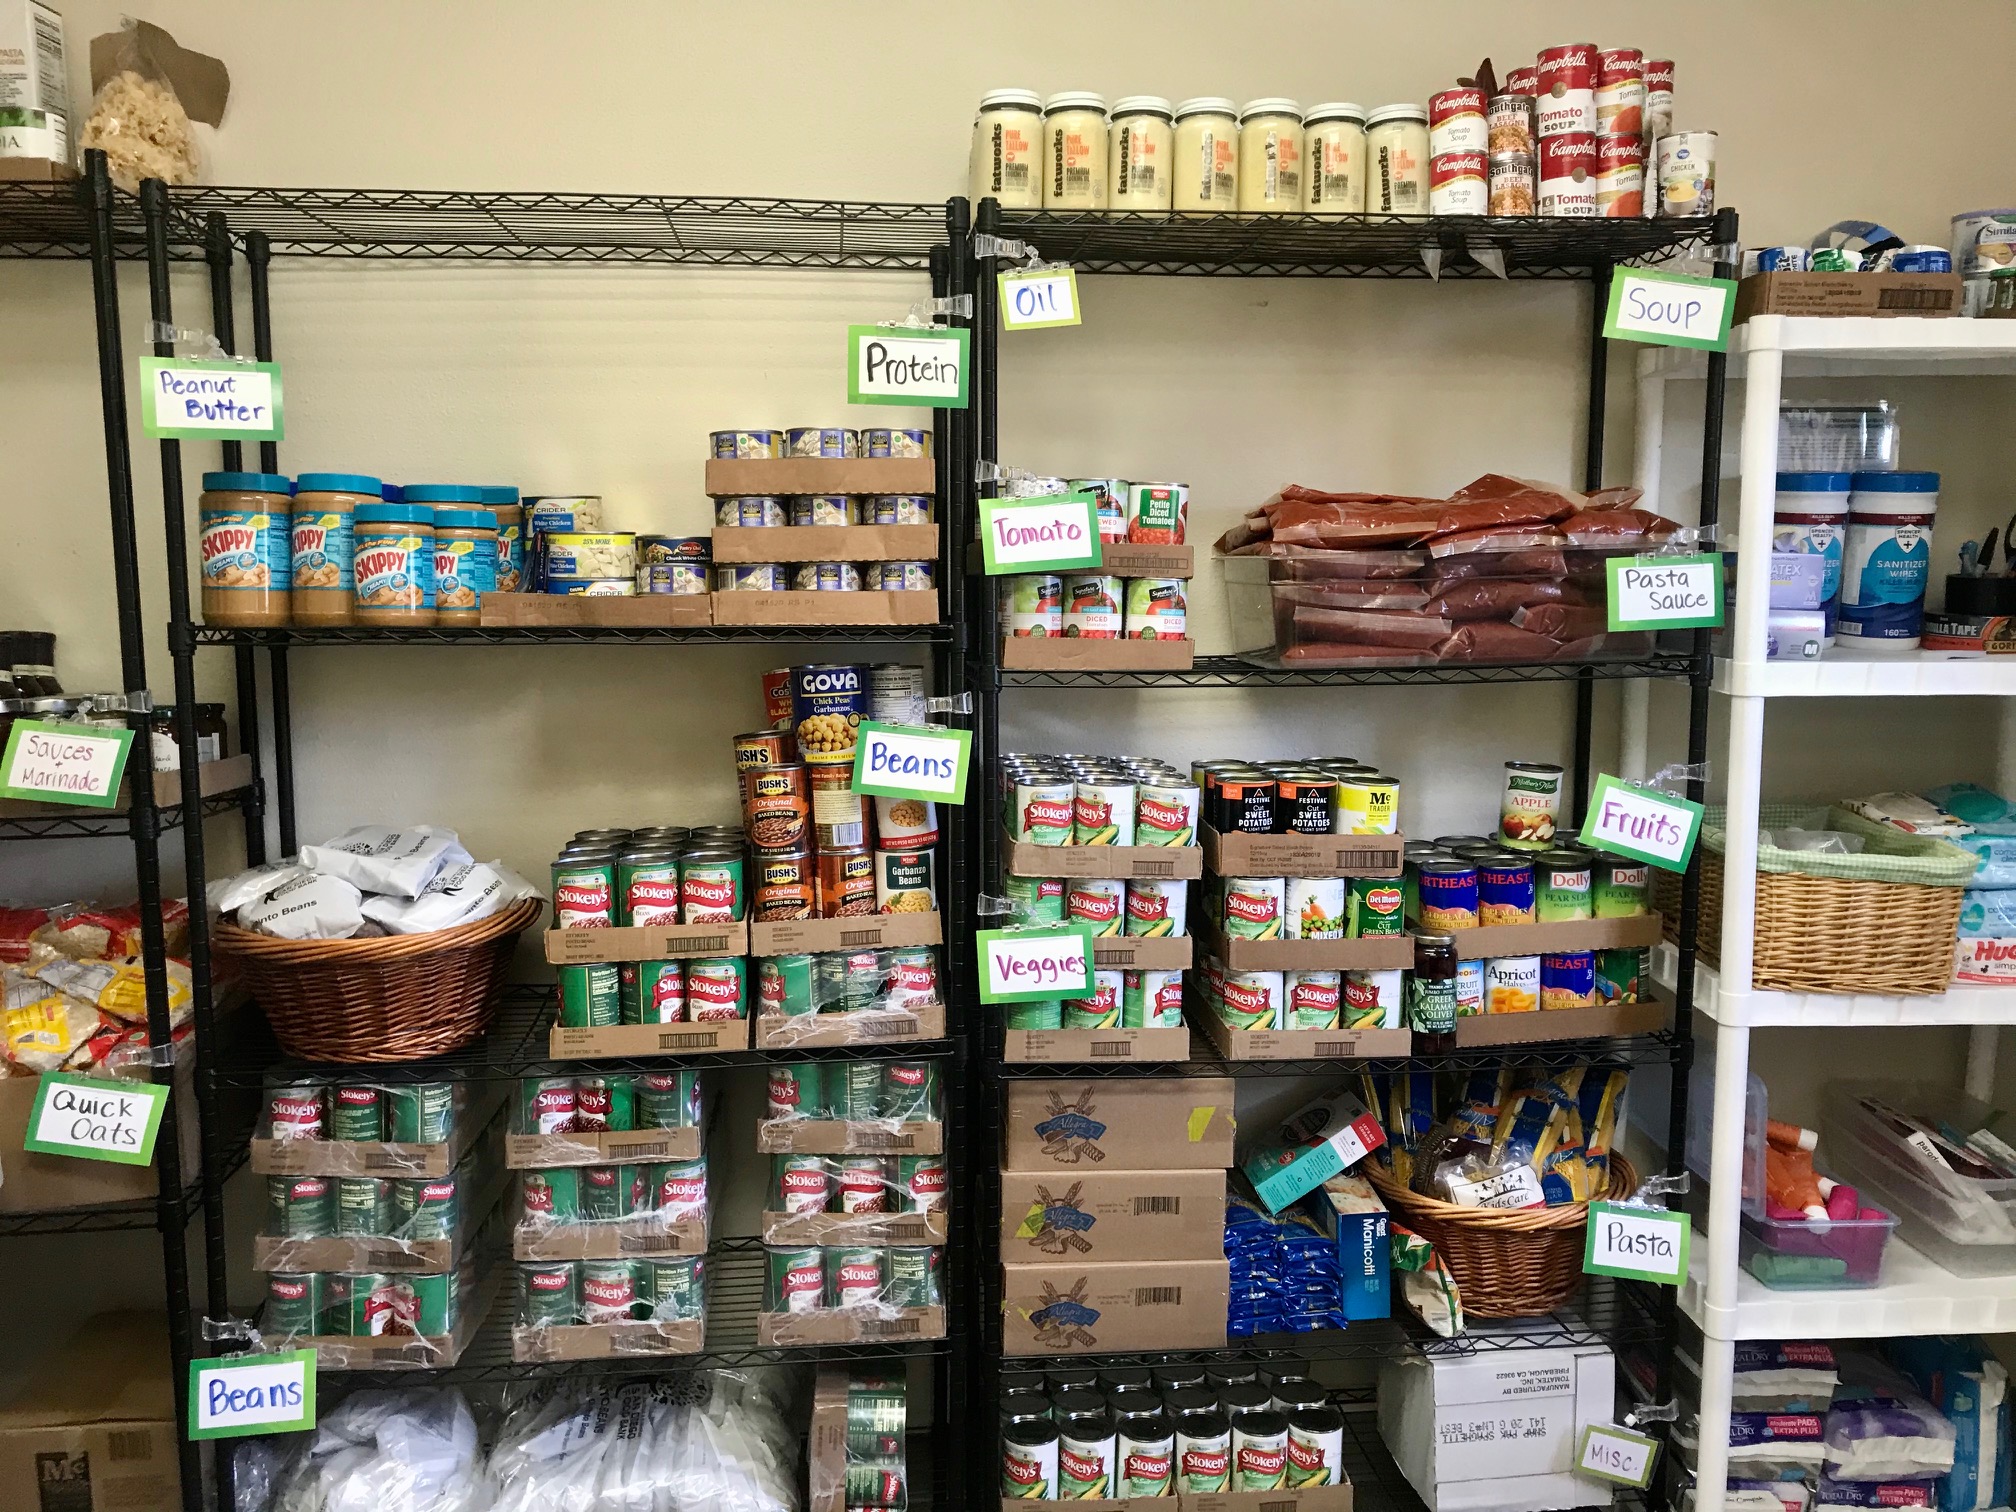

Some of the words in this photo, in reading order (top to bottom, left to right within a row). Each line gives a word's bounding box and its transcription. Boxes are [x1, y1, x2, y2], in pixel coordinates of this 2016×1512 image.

[1435, 93, 1481, 112] Campbell's
[1540, 107, 1583, 123] Tomato
[1447, 127, 1471, 136] Tomato
[1544, 121, 1576, 132] SOUP
[1005, 130, 1021, 140] PURE
[1066, 134, 1082, 145] PURE
[1450, 134, 1468, 142] Soup
[991, 122, 1002, 192] fatworks
[1053, 129, 1063, 198] fatworks
[1118, 126, 1130, 195] fatworks
[1311, 137, 1322, 204] fatworks
[1436, 157, 1482, 173] Campbell's
[1379, 145, 1392, 212] fatworks
[1563, 206, 1593, 215] SOUP
[1985, 223, 2016, 237] Simila
[1015, 284, 1058, 316] Oil
[866, 341, 958, 385] Protein
[160, 370, 237, 395] Peanut
[184, 398, 267, 422] Butter
[1149, 499, 1171, 509] Petite
[1149, 508, 1170, 517] Diced
[1141, 516, 1176, 526] Tomatoes
[993, 516, 1082, 548] Tomato
[201, 528, 254, 561] SKIPPY
[355, 551, 405, 584] SKIPPY
[1770, 564, 1802, 576] ATEX
[1876, 560, 1927, 568] SANITIZER
[1625, 568, 1690, 590] Pasta
[1889, 570, 1918, 578] WIPES
[1883, 628, 1900, 637] 160
[1951, 622, 1979, 636] TAPE
[802, 672, 860, 694] GOYA
[813, 696, 833, 706] Chick
[834, 695, 851, 705] Peas
[813, 704, 852, 714] Garbanzos
[27, 735, 94, 762] Sauces
[871, 741, 956, 779] Beans
[22, 767, 100, 792] Marinade
[757, 778, 789, 791] BUSH'S
[757, 797, 793, 808] Original
[1369, 805, 1391, 813] TRADER
[1511, 796, 1552, 807] APPLE
[1139, 802, 1185, 823] Stokely's
[1245, 811, 1270, 819] SWEET
[1298, 811, 1326, 819] SWEET
[1238, 818, 1273, 827] POTATOES
[1292, 818, 1331, 827] POTATOES
[1601, 800, 1683, 846] Fruits
[766, 866, 798, 880] BUSH'S
[892, 866, 927, 876] Garbanzo
[898, 875, 922, 886] Beans
[1553, 873, 1590, 889] Dolly
[558, 886, 608, 907] Stokely's
[684, 880, 732, 900] Stokely's
[765, 886, 801, 897] Original
[281, 899, 318, 917] Beans
[1070, 893, 1116, 913] Stokely's
[1228, 894, 1274, 914] Stokely's
[1310, 930, 1337, 940] MIXED
[1362, 927, 1383, 935] GREEN
[996, 954, 1090, 983] Veggies
[1487, 966, 1537, 984] Apricot
[690, 978, 736, 998] Stokely's
[1427, 995, 1453, 1004] GREEK
[1426, 1010, 1453, 1019] OLIVES
[53, 1089, 134, 1118] Quick
[271, 1100, 323, 1117] Stokely's
[70, 1117, 137, 1145] Oats
[1362, 1218, 1376, 1276] Manicotti
[1607, 1221, 1673, 1258] Pasta
[583, 1281, 631, 1300] Stokely's
[1502, 1387, 1512, 1395] BY
[1512, 1383, 1570, 1395] MANUFACTURED
[208, 1379, 303, 1417] Beans
[1797, 1418, 1817, 1427] PADS
[1442, 1431, 1495, 1445] SPAGHETTI
[1774, 1427, 1799, 1435] EXTRA
[1800, 1427, 1819, 1435] PLUS
